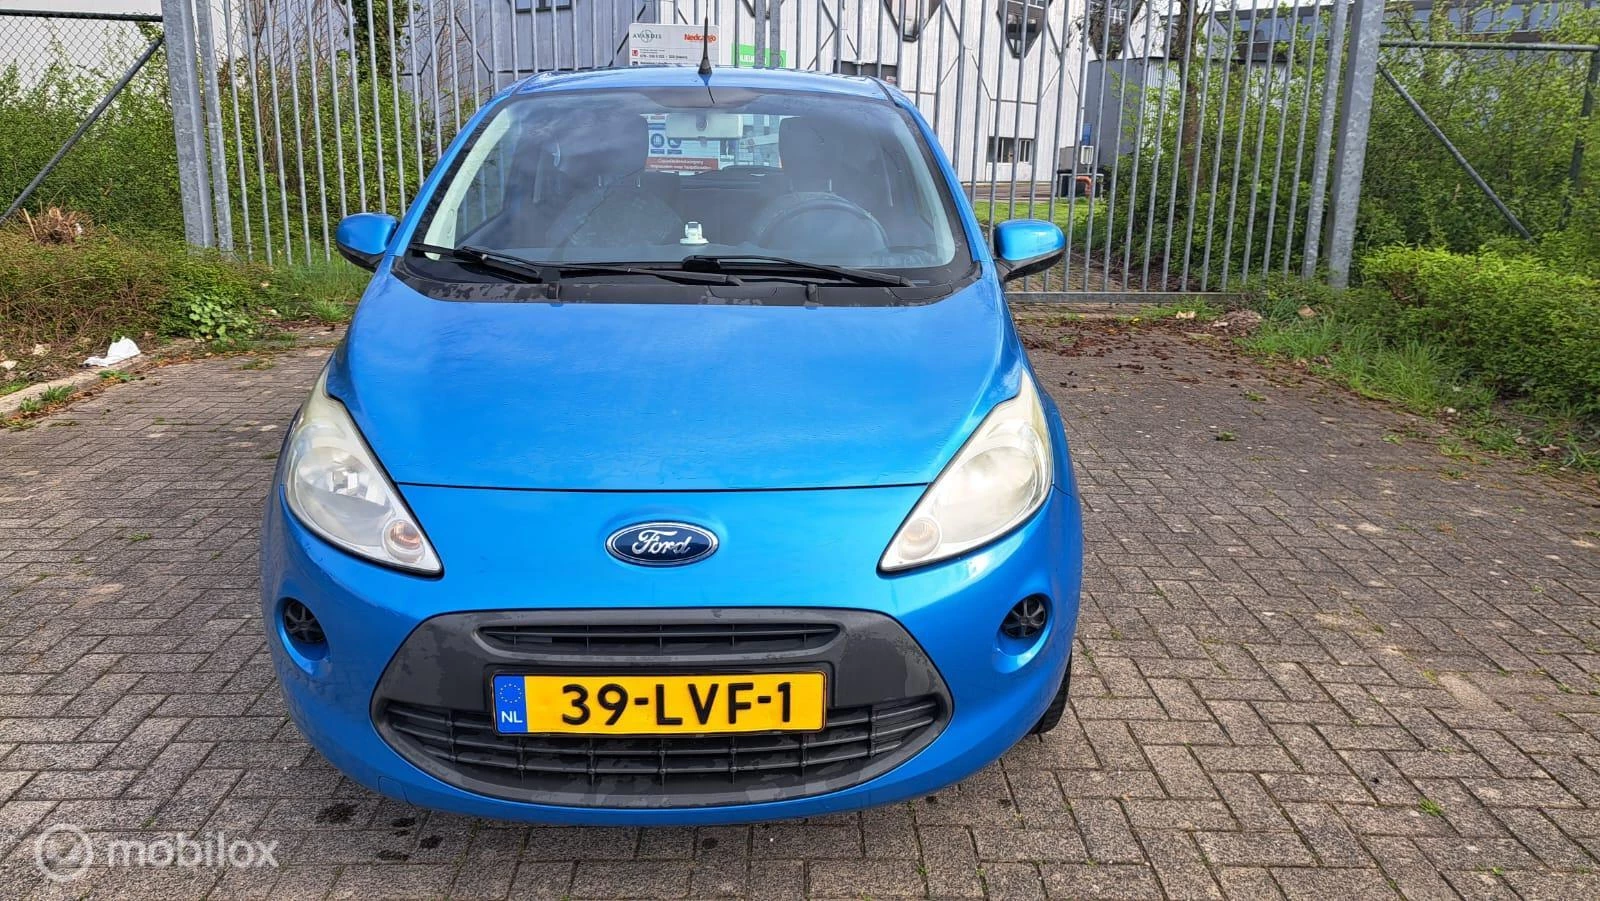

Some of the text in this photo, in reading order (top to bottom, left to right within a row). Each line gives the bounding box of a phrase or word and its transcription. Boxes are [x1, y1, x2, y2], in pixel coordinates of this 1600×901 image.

[684, 33, 717, 43] Nedcago
[631, 529, 691, 556] Ford
[561, 681, 792, 726] 39-LVF-1
[501, 711, 523, 724] NL
